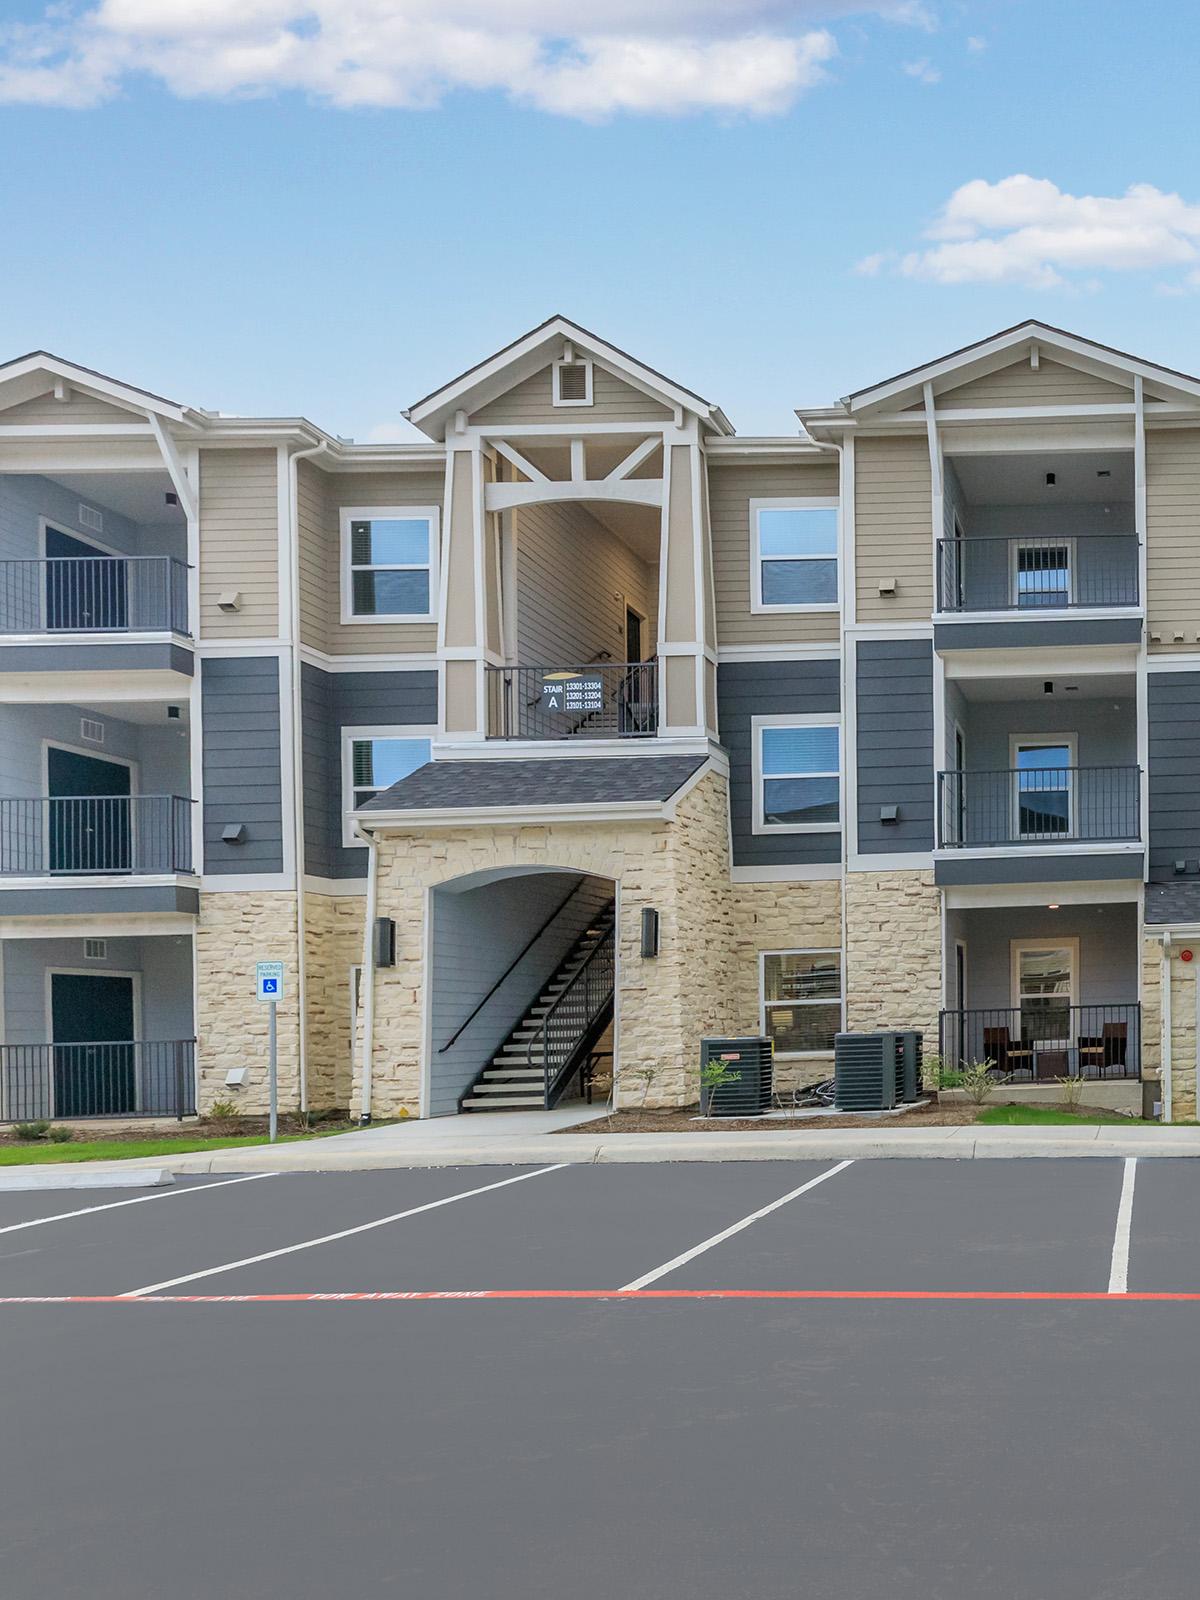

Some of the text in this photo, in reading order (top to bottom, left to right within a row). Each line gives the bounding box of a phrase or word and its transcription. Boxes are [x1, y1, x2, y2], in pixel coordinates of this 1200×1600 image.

[543, 685, 563, 693] STAIR
[566, 682, 601, 690] 13301-13304
[566, 691, 601, 700] 13201-13204
[548, 696, 558, 708] A
